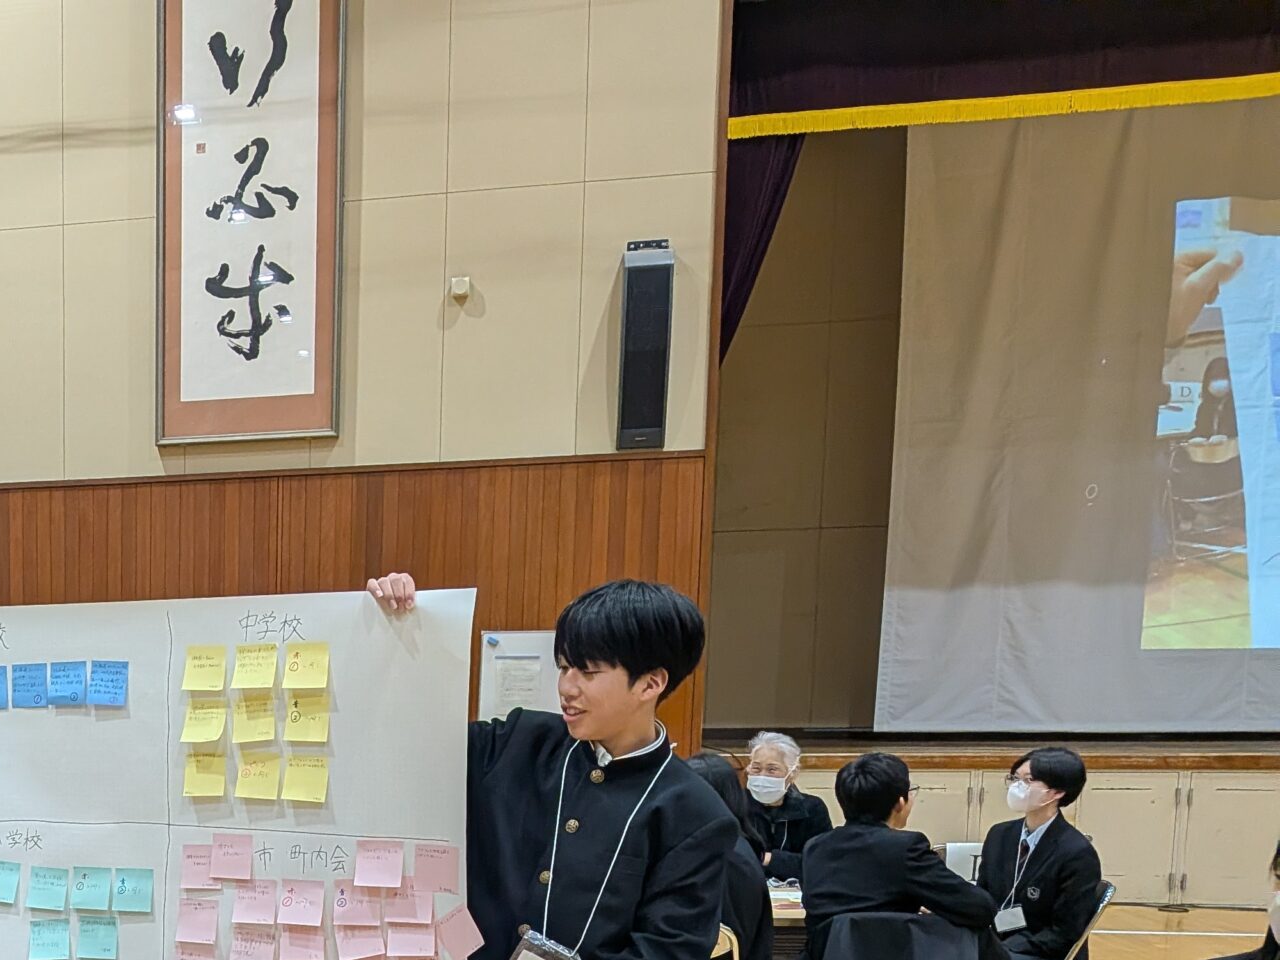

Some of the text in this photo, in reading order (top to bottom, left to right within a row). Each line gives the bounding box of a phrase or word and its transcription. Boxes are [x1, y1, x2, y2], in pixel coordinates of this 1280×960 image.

[1180, 386, 1192, 398] D
[238, 609, 306, 643] 中学校
[254, 841, 274, 871] 市
[290, 844, 349, 874] 町内会
